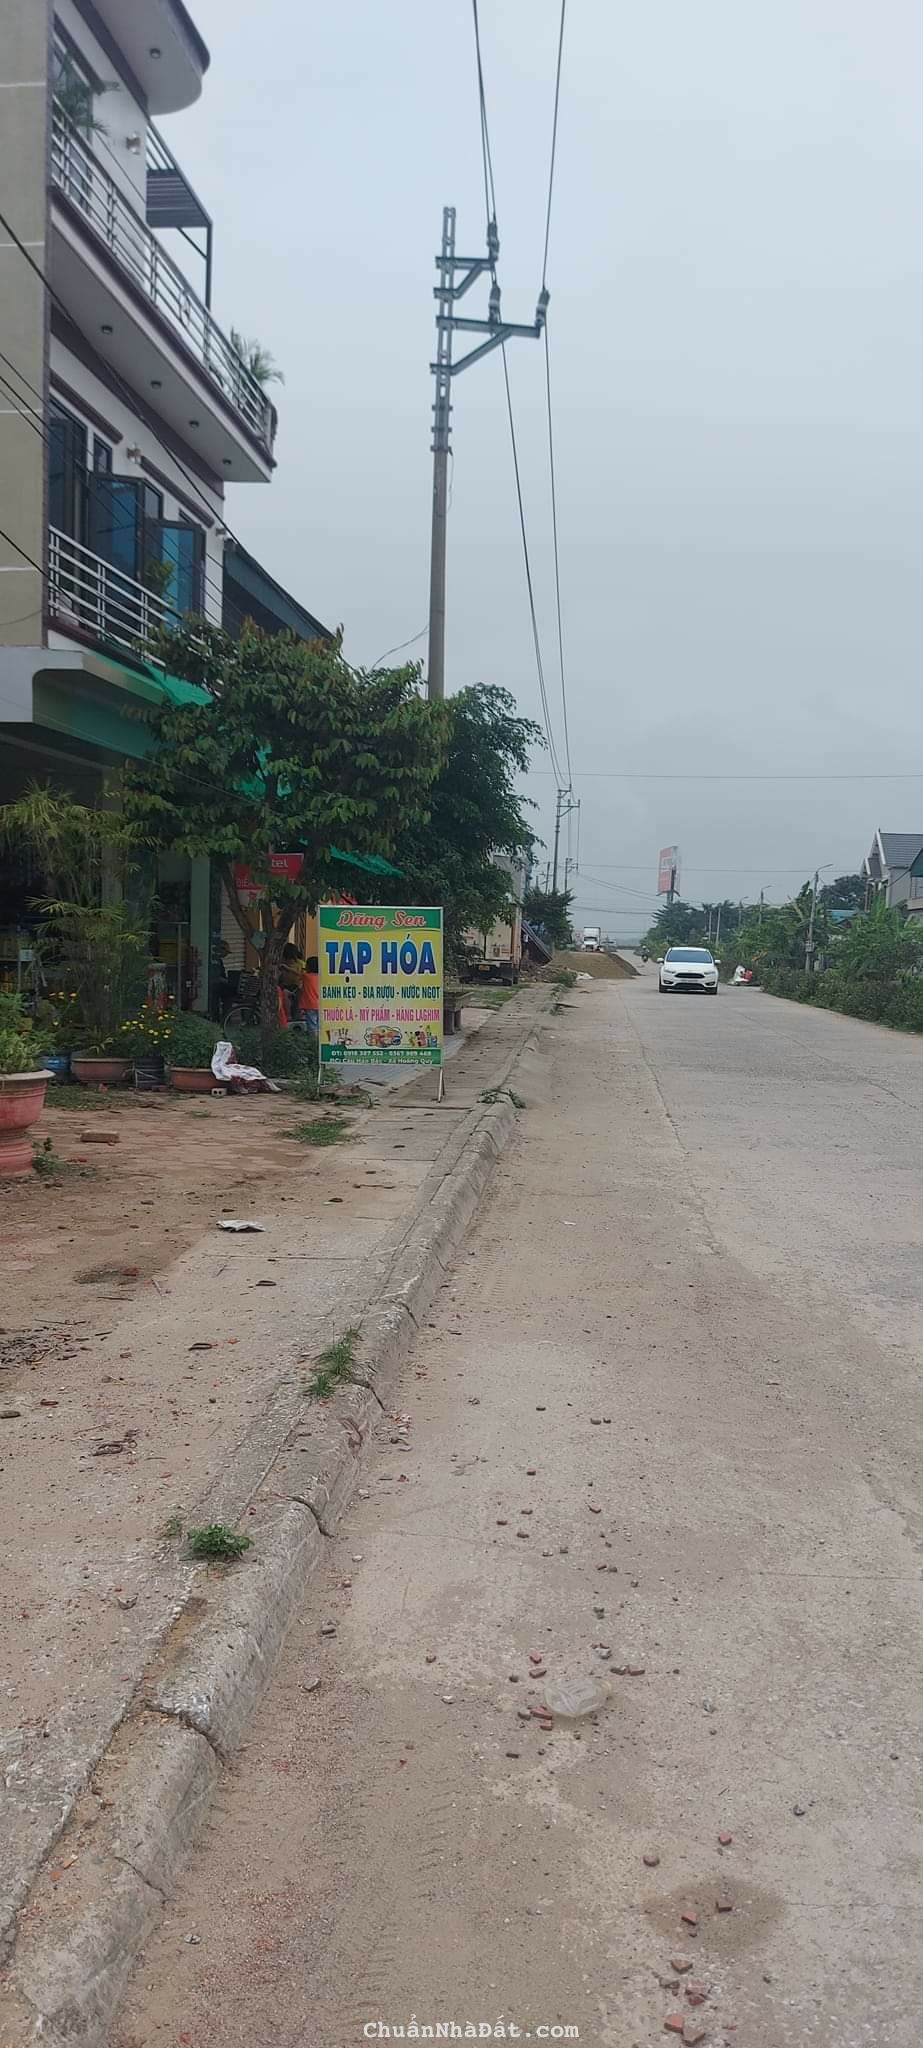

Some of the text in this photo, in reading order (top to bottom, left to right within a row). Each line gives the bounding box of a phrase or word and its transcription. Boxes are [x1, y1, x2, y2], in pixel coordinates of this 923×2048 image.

[338, 911, 426, 929] Dũng Sen
[325, 933, 436, 983] TẠP HÓA
[322, 984, 341, 999] BÁNH
[343, 985, 356, 1001] KẸO
[376, 985, 395, 1001] RƯỢU
[401, 984, 420, 999] NƯỚC
[422, 985, 440, 1001] NGỌT
[323, 1005, 344, 1021] THUỐC
[345, 1006, 354, 1021] LÁ
[396, 1006, 414, 1021] HÀNG
